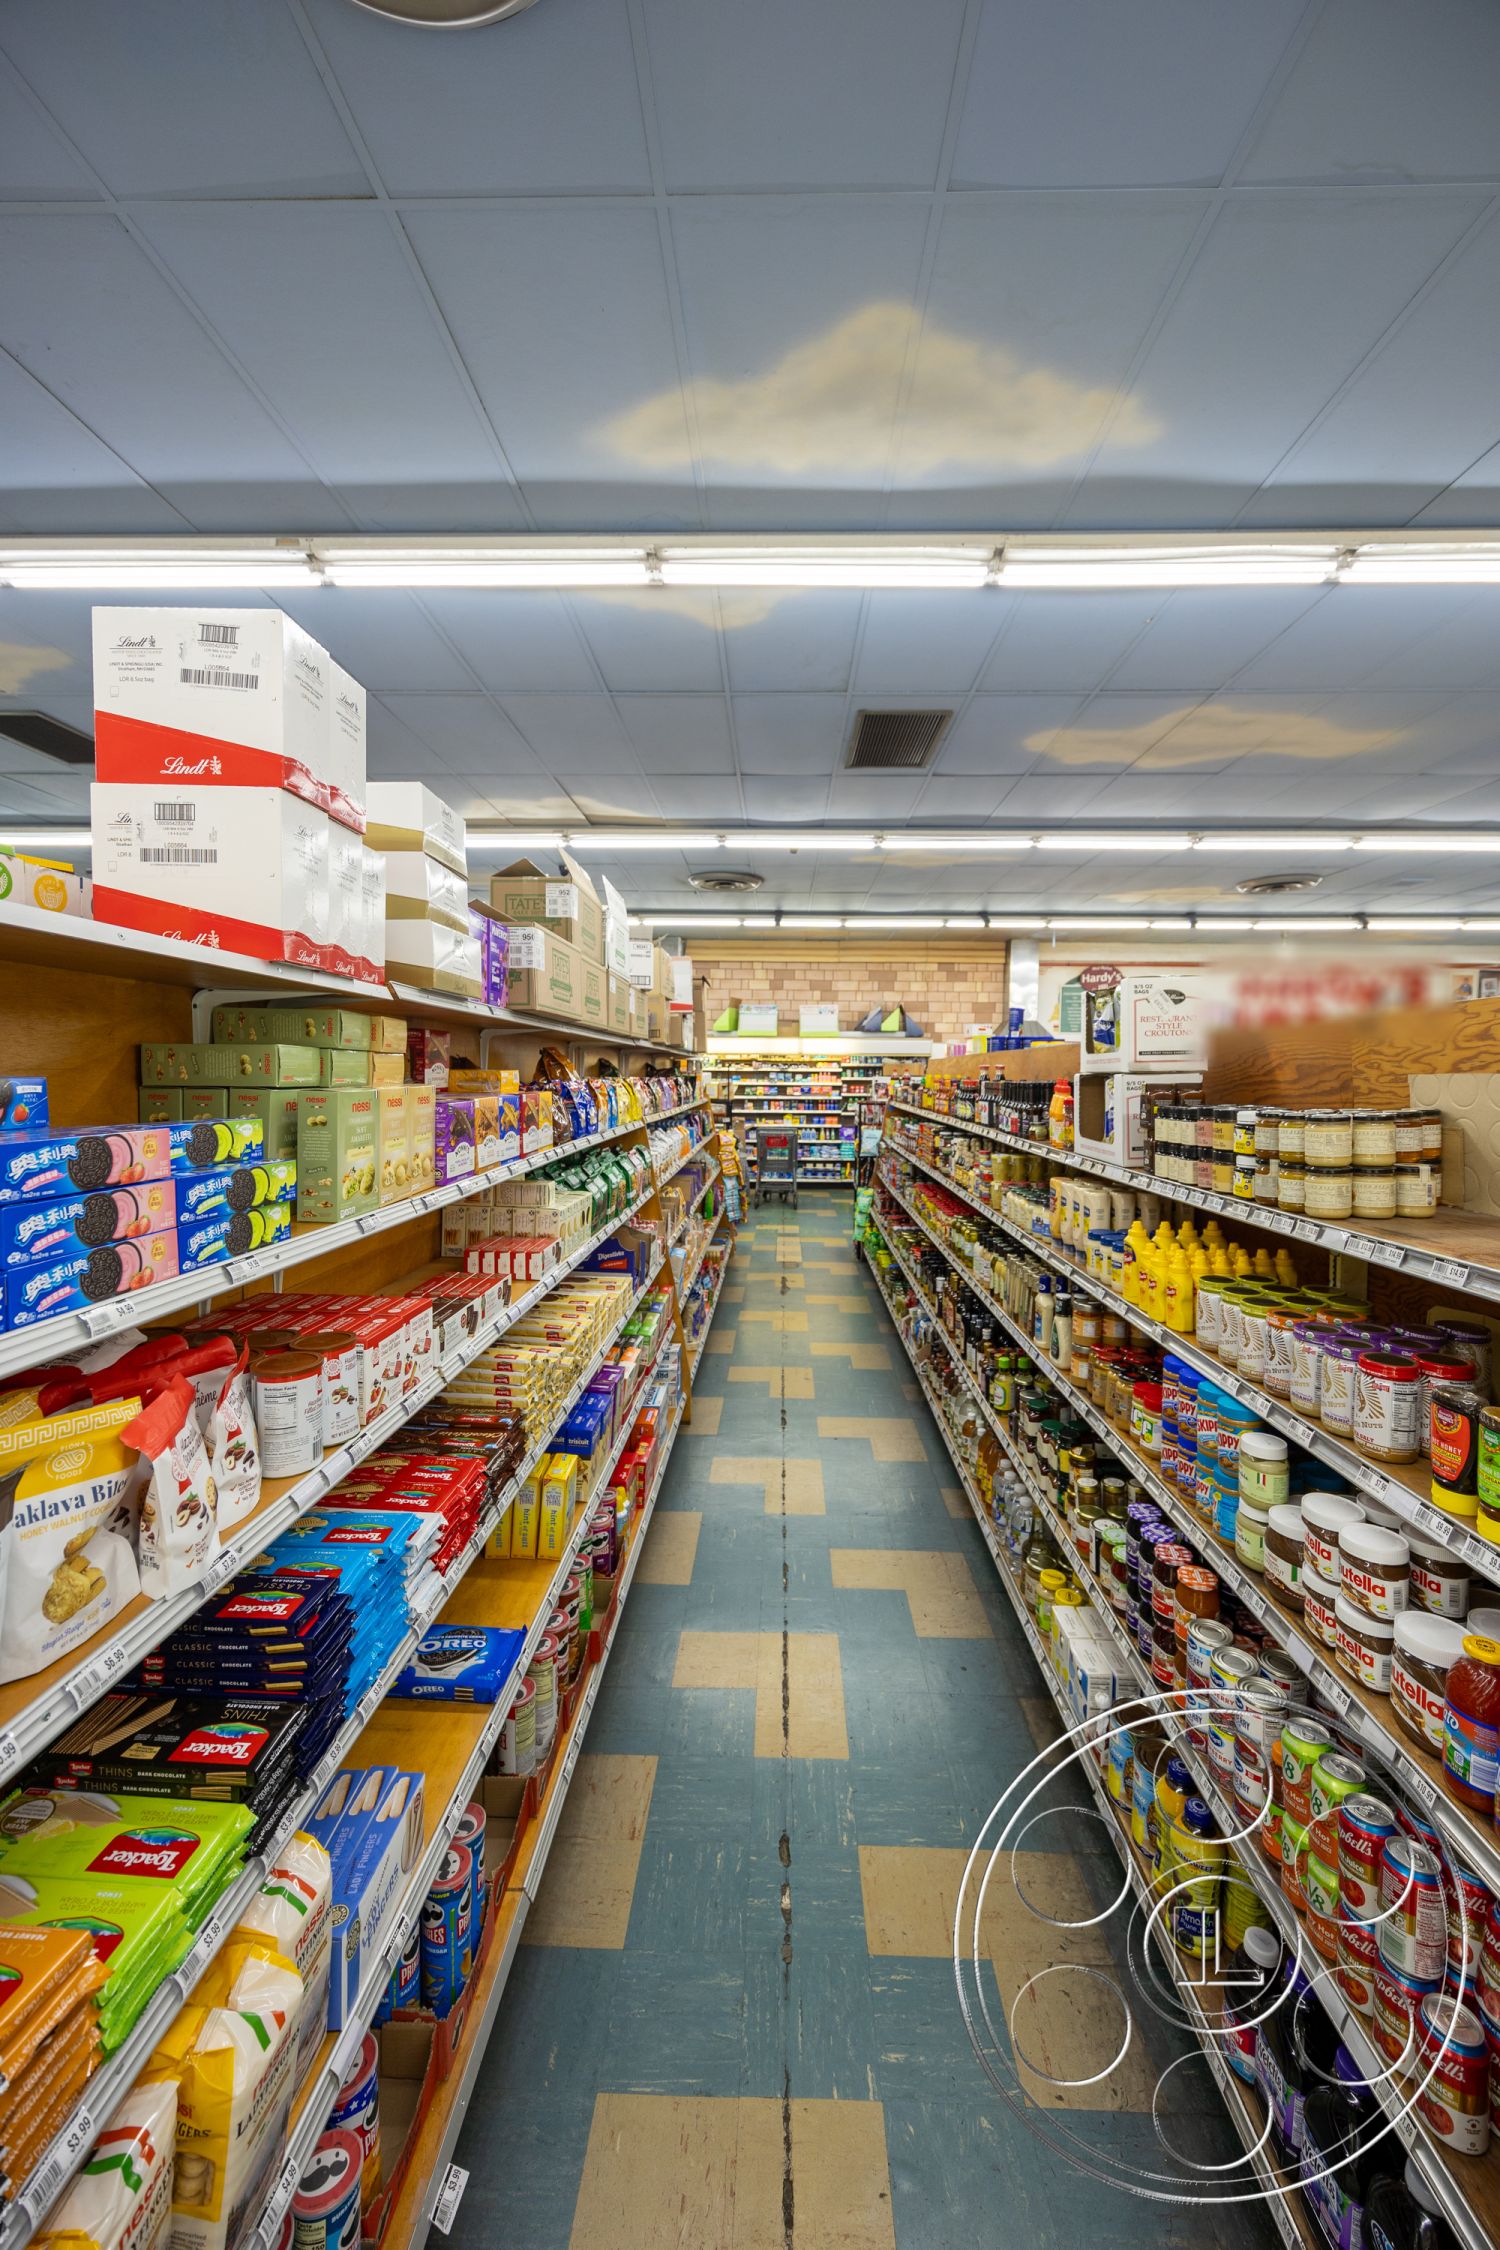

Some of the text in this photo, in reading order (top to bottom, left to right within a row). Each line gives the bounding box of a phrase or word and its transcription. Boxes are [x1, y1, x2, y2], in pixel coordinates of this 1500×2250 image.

[117, 635, 147, 648] Lindt
[300, 654, 316, 673] Lindt
[159, 756, 209, 775] Lindt
[558, 888, 571, 896] 952
[298, 949, 316, 964] Lindt
[335, 960, 351, 975] Lindt
[362, 970, 376, 982] Lindt
[1081, 970, 1122, 984] Hardy's
[170, 1129, 193, 1145] 利奥
[9, 1142, 77, 1180] 奥利奥
[188, 1175, 233, 1206] 奥利奥
[18, 1202, 85, 1240] 奥利奥
[25, 1258, 89, 1295] 奥利奥
[1449, 1268, 1466, 1279] $14.99
[195, 1389, 217, 1408] rème
[568, 1437, 590, 1446] triscuit
[1360, 1434, 1374, 1443] SALT
[1440, 1443, 1462, 1455] HONEY
[56, 1469, 83, 1481] FOODS
[412, 1471, 453, 1481] Loacker
[14, 1492, 87, 1528] aklava
[385, 1497, 430, 1507] Loacker
[19, 1511, 89, 1542] HONEY WALNUT
[1436, 1521, 1450, 1536] $9.99
[330, 1532, 383, 1542] Loacker
[1306, 1531, 1332, 1561] tella
[222, 1555, 238, 1571] $7.99
[254, 1582, 312, 1590] CLASSIC
[1341, 1565, 1386, 1598] utella
[227, 1603, 291, 1616] Loacker
[172, 1643, 213, 1651] CLASSIC
[417, 1639, 487, 1652] OREO
[1336, 1631, 1375, 1668] utella
[104, 1648, 126, 1671] $6.99
[176, 1661, 216, 1669] CLASSIC
[175, 1677, 214, 1686] CLASSIC
[411, 1685, 445, 1694] OREO
[1392, 1664, 1445, 1721] utella
[220, 1709, 270, 1721] THINS
[182, 1740, 252, 1759] Loacker
[70, 1763, 91, 1772] Loacker
[98, 1766, 134, 1778] THINS
[55, 1777, 78, 1786] Loacker
[83, 1780, 118, 1792] THINS
[139, 1786, 172, 1794] CHOCOLATE
[1416, 1778, 1435, 1803] $10.99
[1290, 1789, 1305, 1804] Hot
[281, 1813, 296, 1834] $3.99
[331, 1826, 350, 1863] FINGERS
[1315, 1829, 1331, 1844] Hot
[103, 1849, 181, 1872] Loacker
[348, 1833, 378, 1895] LADY FINGERS
[1345, 1858, 1365, 1875] Juice
[96, 1890, 123, 1899] LEMON
[294, 1897, 326, 1959] nessi
[1180, 1917, 1198, 1933] Prune
[1318, 1925, 1335, 1940] Hot
[203, 1922, 222, 1948] $3.99
[1384, 2006, 1407, 2031] Juice
[1429, 2078, 1455, 2100] Juice
[66, 2116, 92, 2153] $3.99
[281, 2163, 298, 2194] $4.99
[448, 2168, 462, 2192] $3.99
